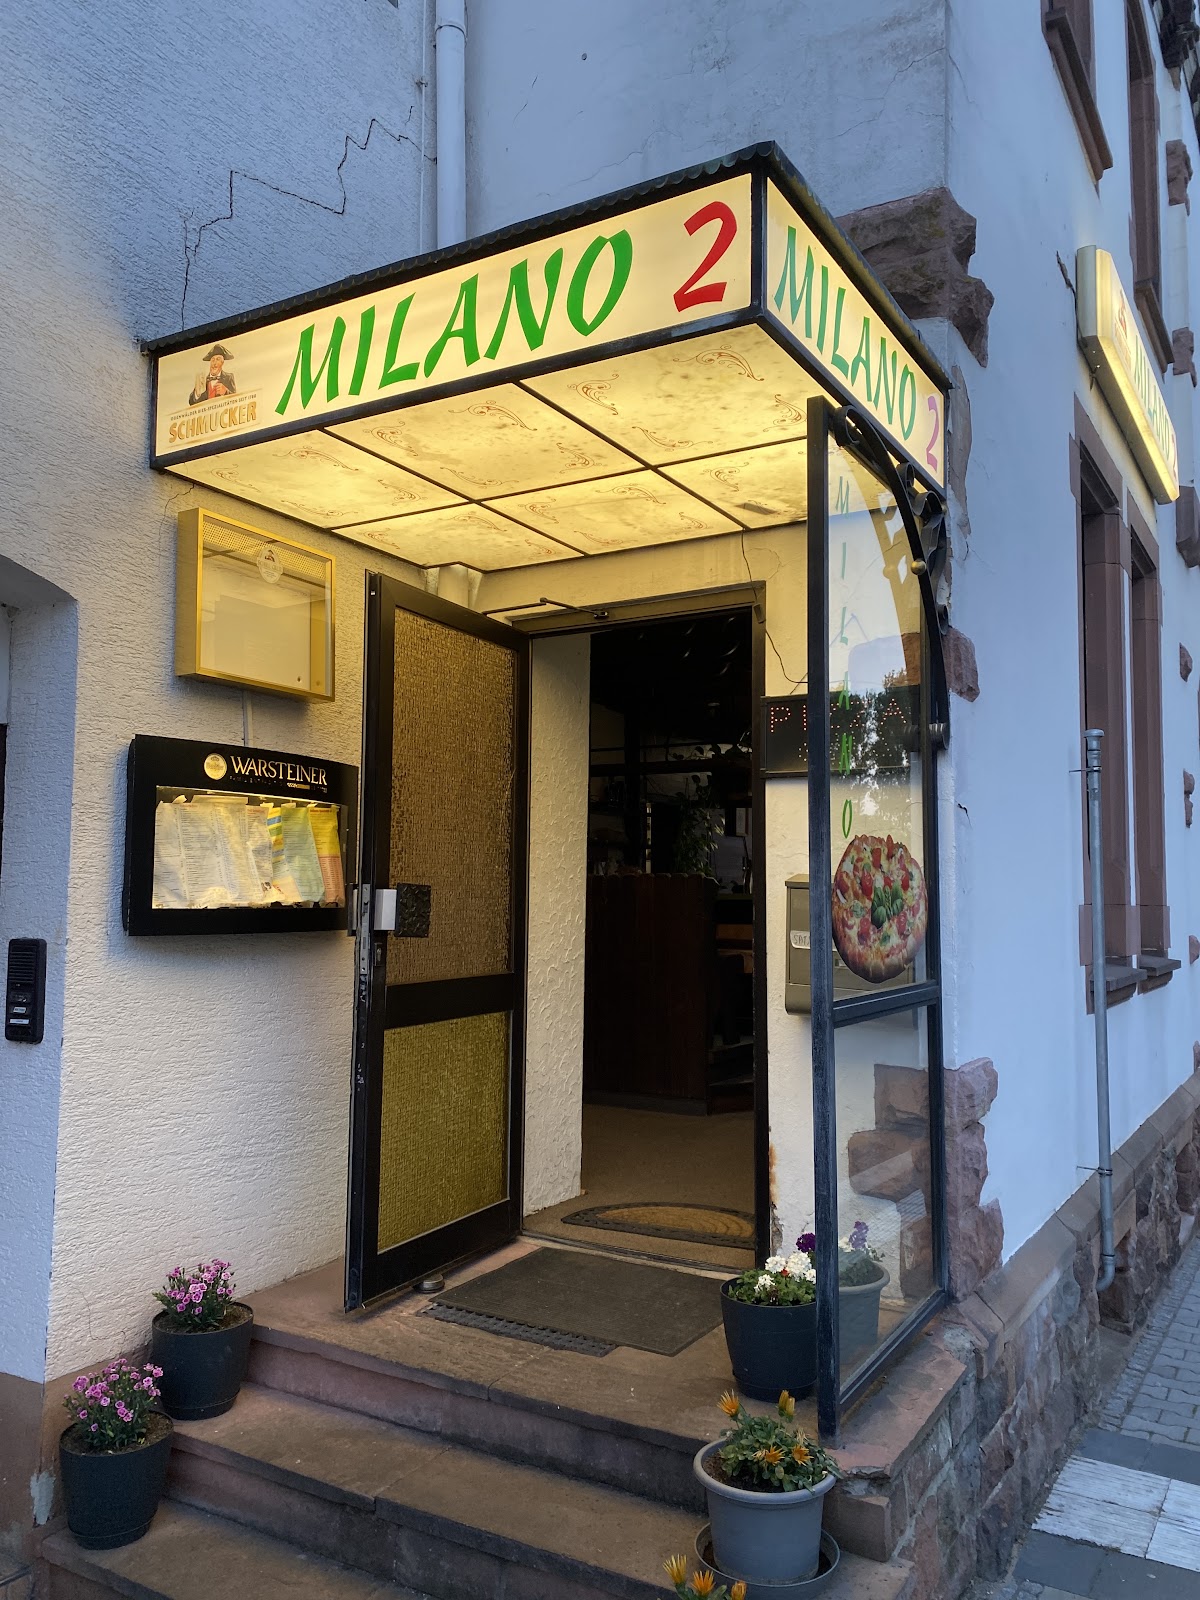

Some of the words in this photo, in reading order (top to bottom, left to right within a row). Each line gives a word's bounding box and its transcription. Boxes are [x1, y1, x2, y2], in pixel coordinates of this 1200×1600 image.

[275, 229, 633, 416] MILANO
[673, 201, 738, 312] 2
[774, 225, 916, 441] MILANO
[926, 395, 940, 473] 2
[168, 401, 257, 443] SCHMUCKER
[1133, 335, 1170, 461] MILANO
[230, 755, 327, 786] WARSTEINER
